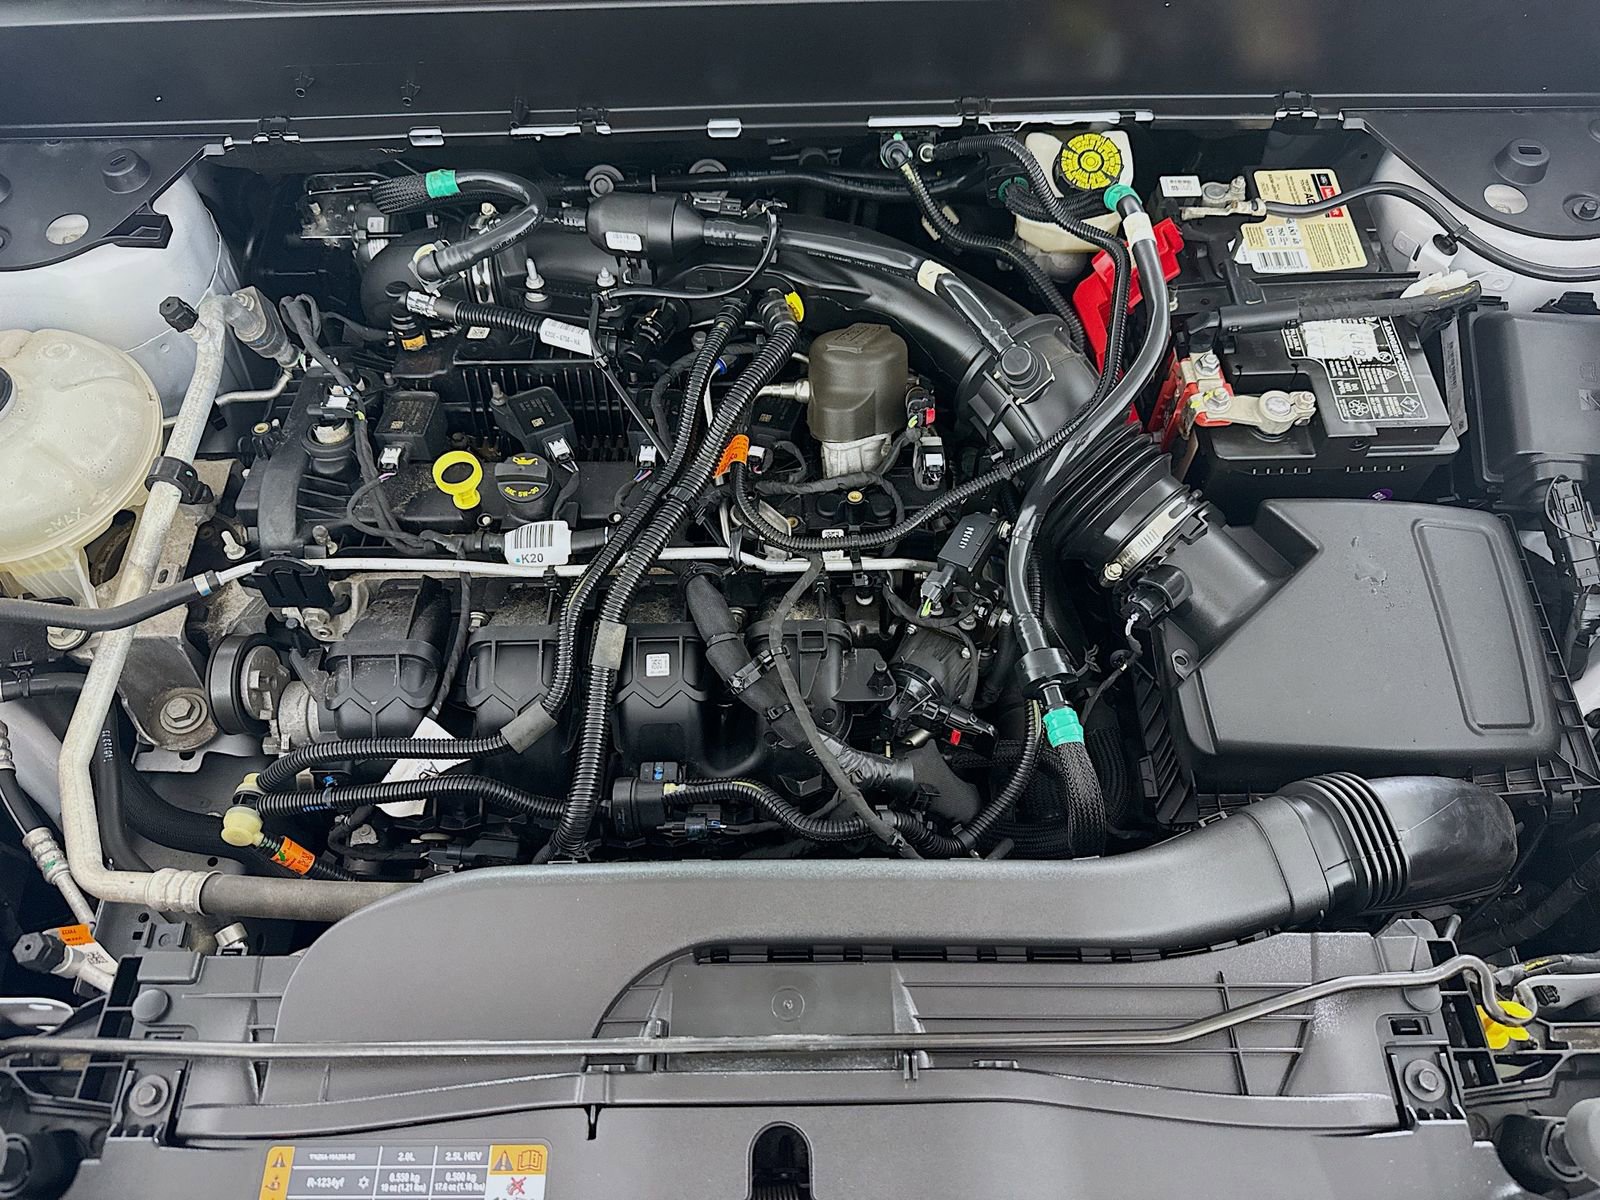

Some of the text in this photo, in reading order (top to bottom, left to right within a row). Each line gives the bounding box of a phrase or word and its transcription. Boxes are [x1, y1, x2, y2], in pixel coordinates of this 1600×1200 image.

[1305, 193, 1316, 204] AG
[1386, 326, 1411, 382] DANGER/POISON
[504, 486, 540, 497] SAE 5W-30
[521, 553, 544, 563] K20
[398, 1152, 416, 1162] 2.0L
[464, 1152, 482, 1161] HEV
[410, 1172, 420, 1184] kg
[467, 1172, 477, 1183] kg
[306, 1177, 344, 1190] R-1234yf
